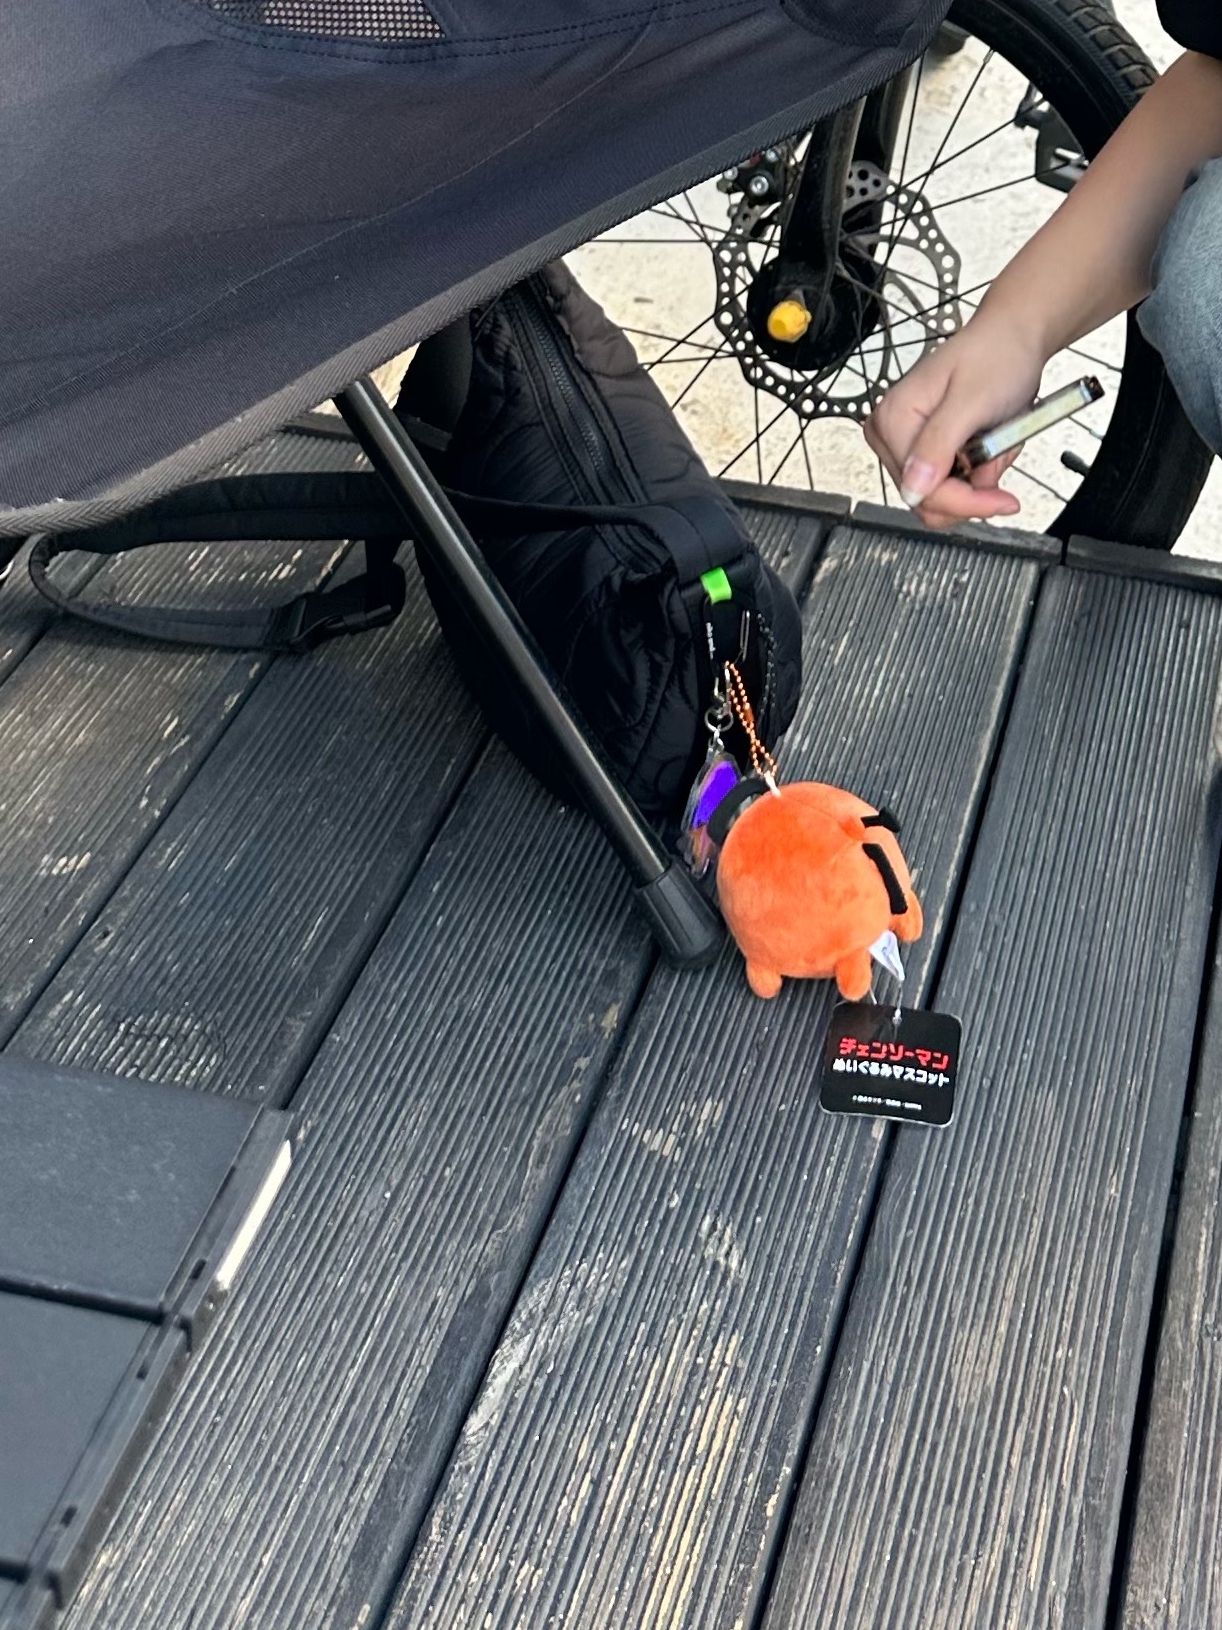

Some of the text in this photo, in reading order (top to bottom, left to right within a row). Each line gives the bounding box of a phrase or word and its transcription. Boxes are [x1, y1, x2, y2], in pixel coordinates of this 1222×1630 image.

[839, 1036, 950, 1071] チェンソーマン
[832, 1057, 951, 1089] ぬいぐるみマスコット
